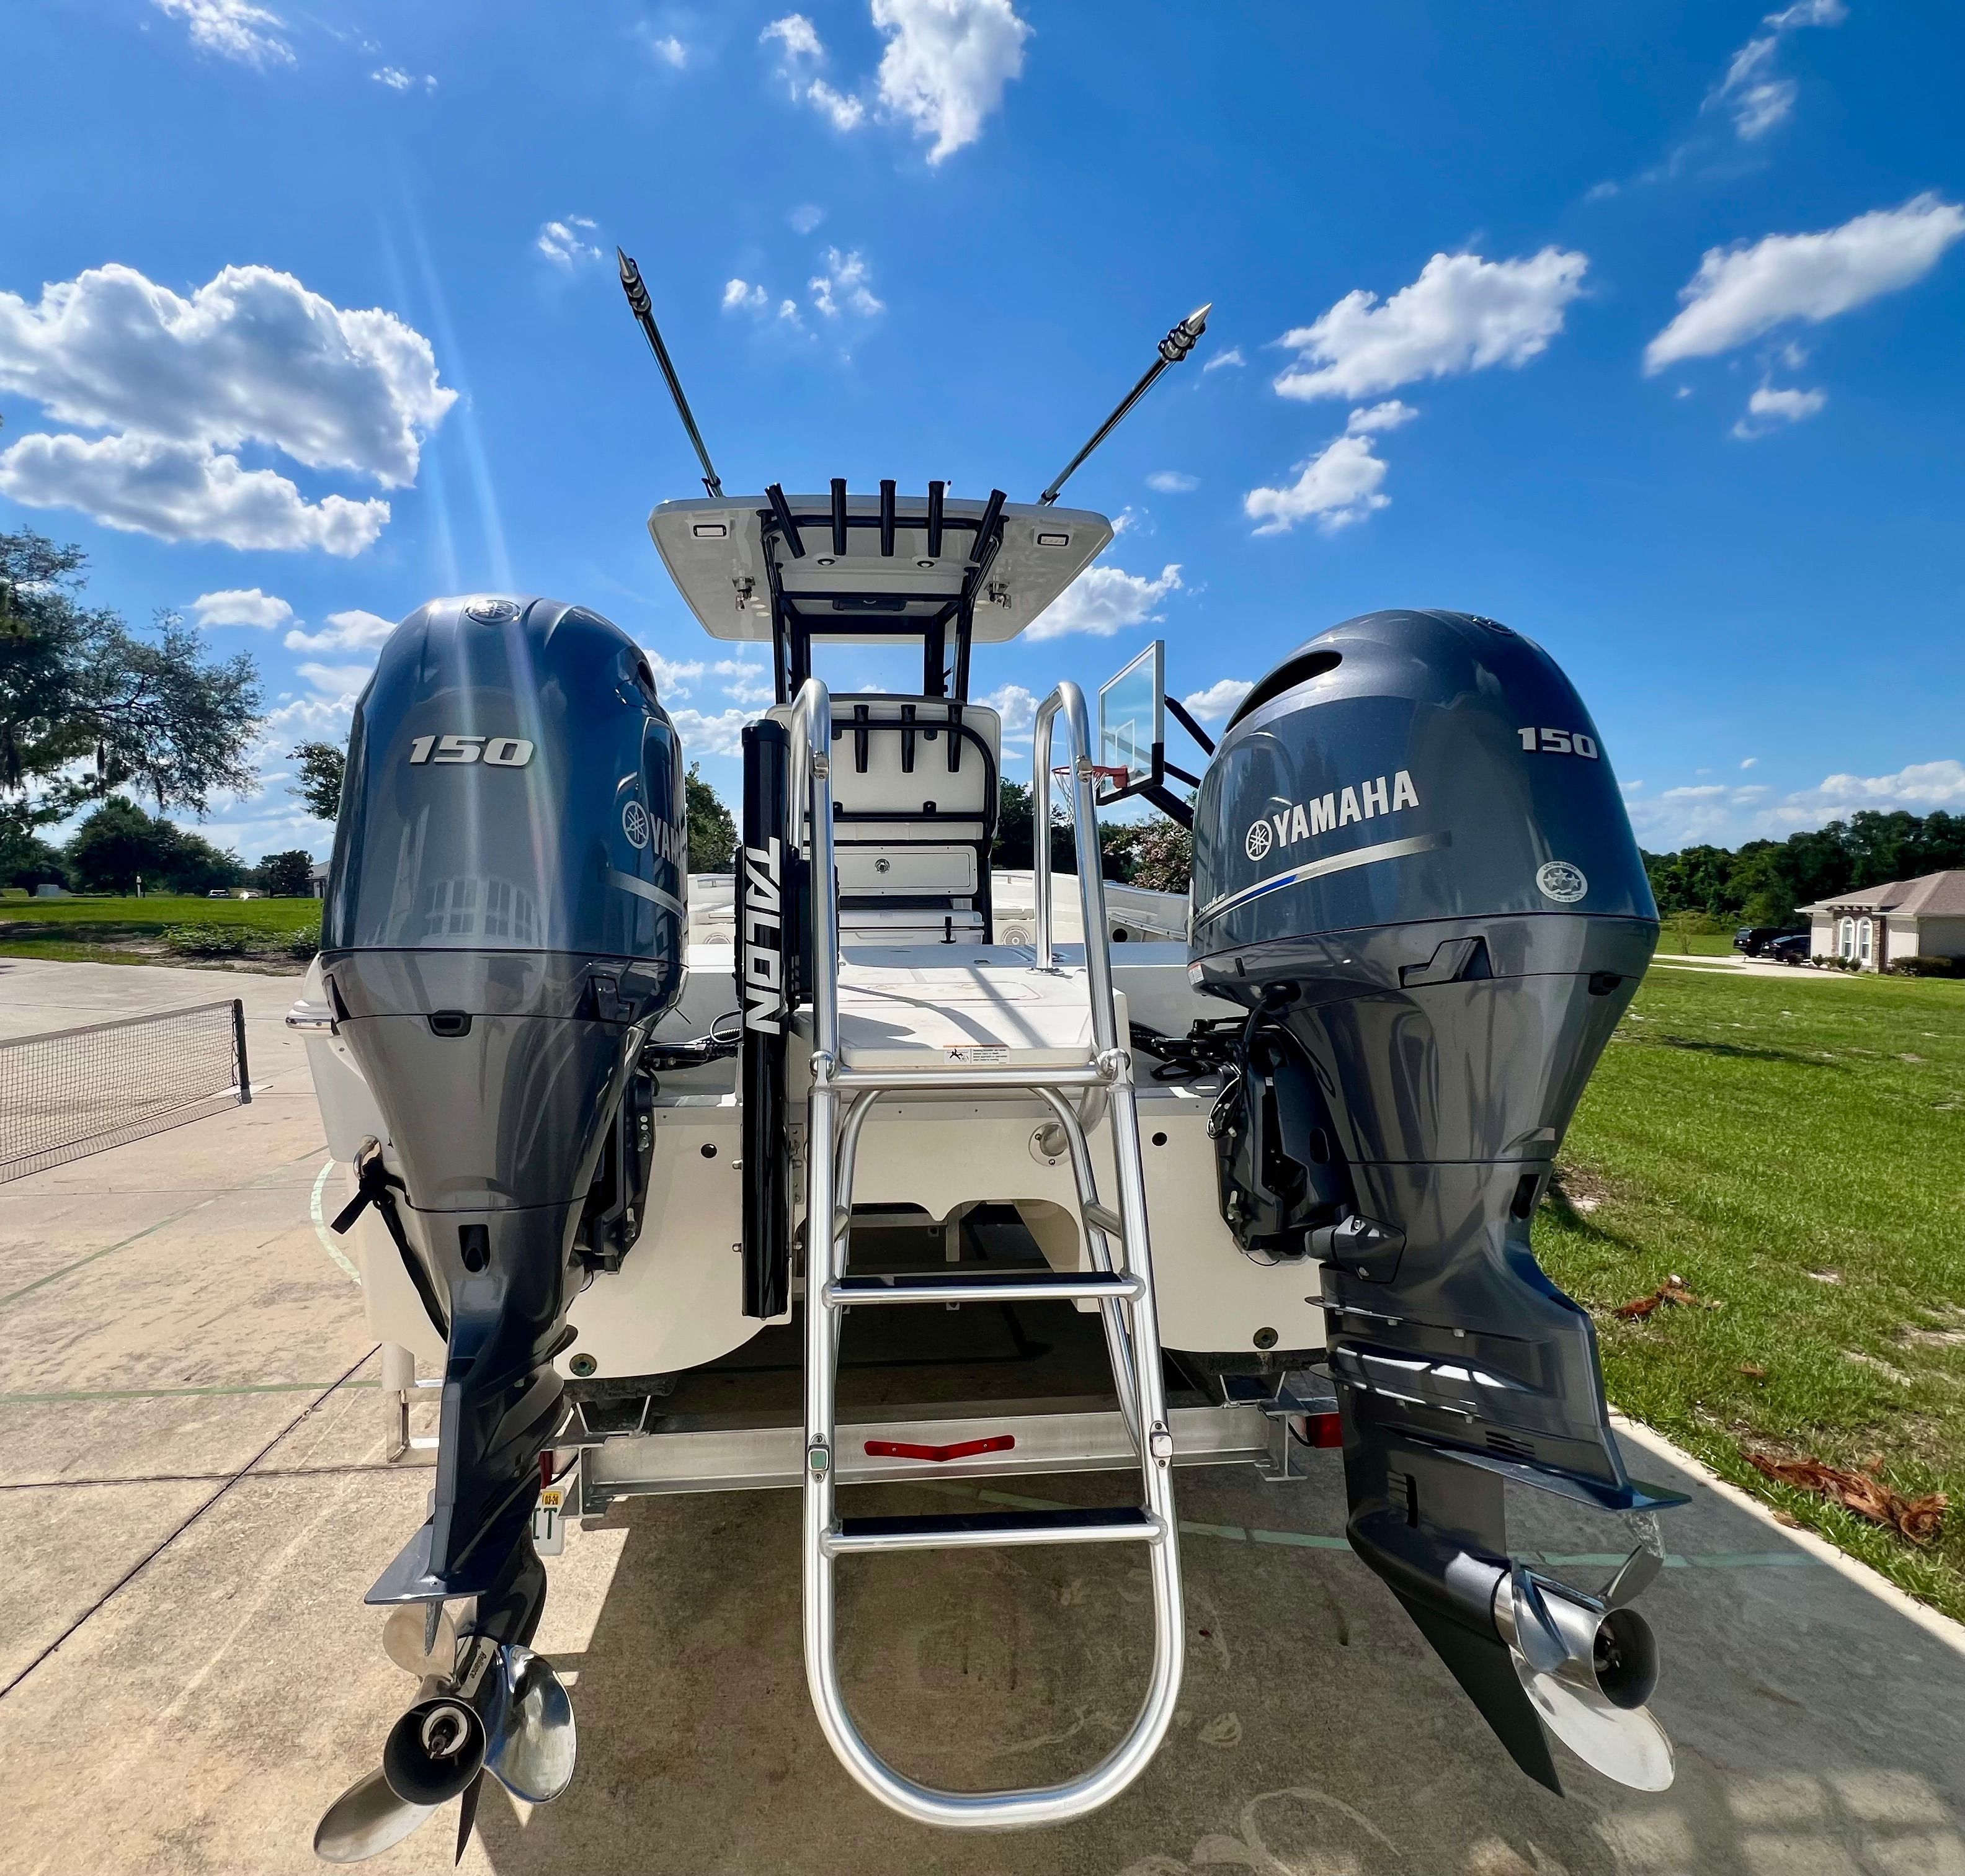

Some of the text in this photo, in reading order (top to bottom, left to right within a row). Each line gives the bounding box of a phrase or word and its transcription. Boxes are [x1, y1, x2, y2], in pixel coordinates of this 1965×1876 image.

[409, 735, 534, 767] 150
[1517, 727, 1598, 759] 150
[1273, 770, 1420, 848] YAMAHA
[746, 836, 780, 1035] TALON
